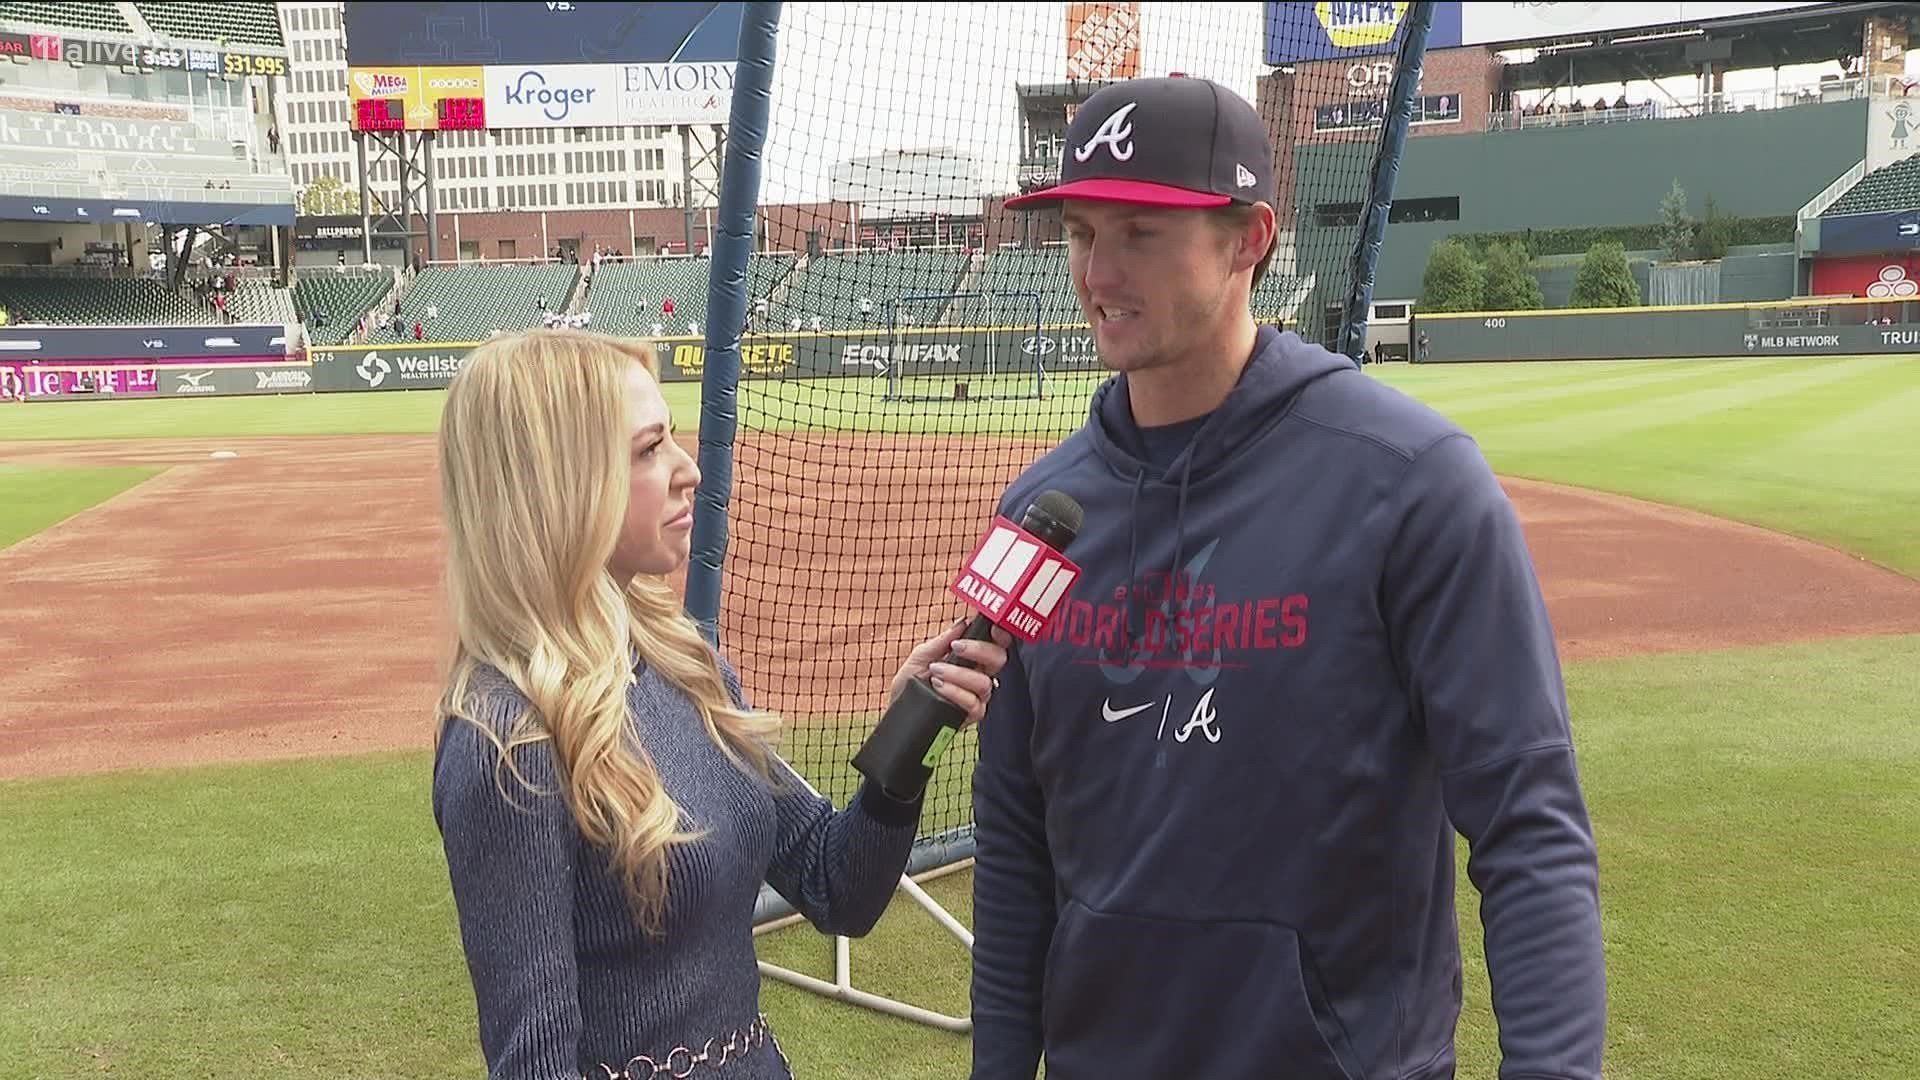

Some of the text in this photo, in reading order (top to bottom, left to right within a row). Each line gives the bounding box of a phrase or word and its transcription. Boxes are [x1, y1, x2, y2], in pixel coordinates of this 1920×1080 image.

[1327, 2, 1397, 25] NAPA
[223, 53, 285, 75] $31,995
[624, 65, 737, 92] EMORY
[505, 71, 596, 121] Kroger
[1485, 318, 1505, 328] 400
[1762, 336, 1784, 347] MLB
[1786, 335, 1840, 347] NETWORK
[313, 353, 335, 363] 375
[841, 344, 962, 365] EQUIFAX
[401, 370, 429, 380] HEALTH
[957, 575, 1006, 615] ALIVE
[1006, 607, 1043, 638] ALIVE
[1174, 594, 1309, 654] SERIES
